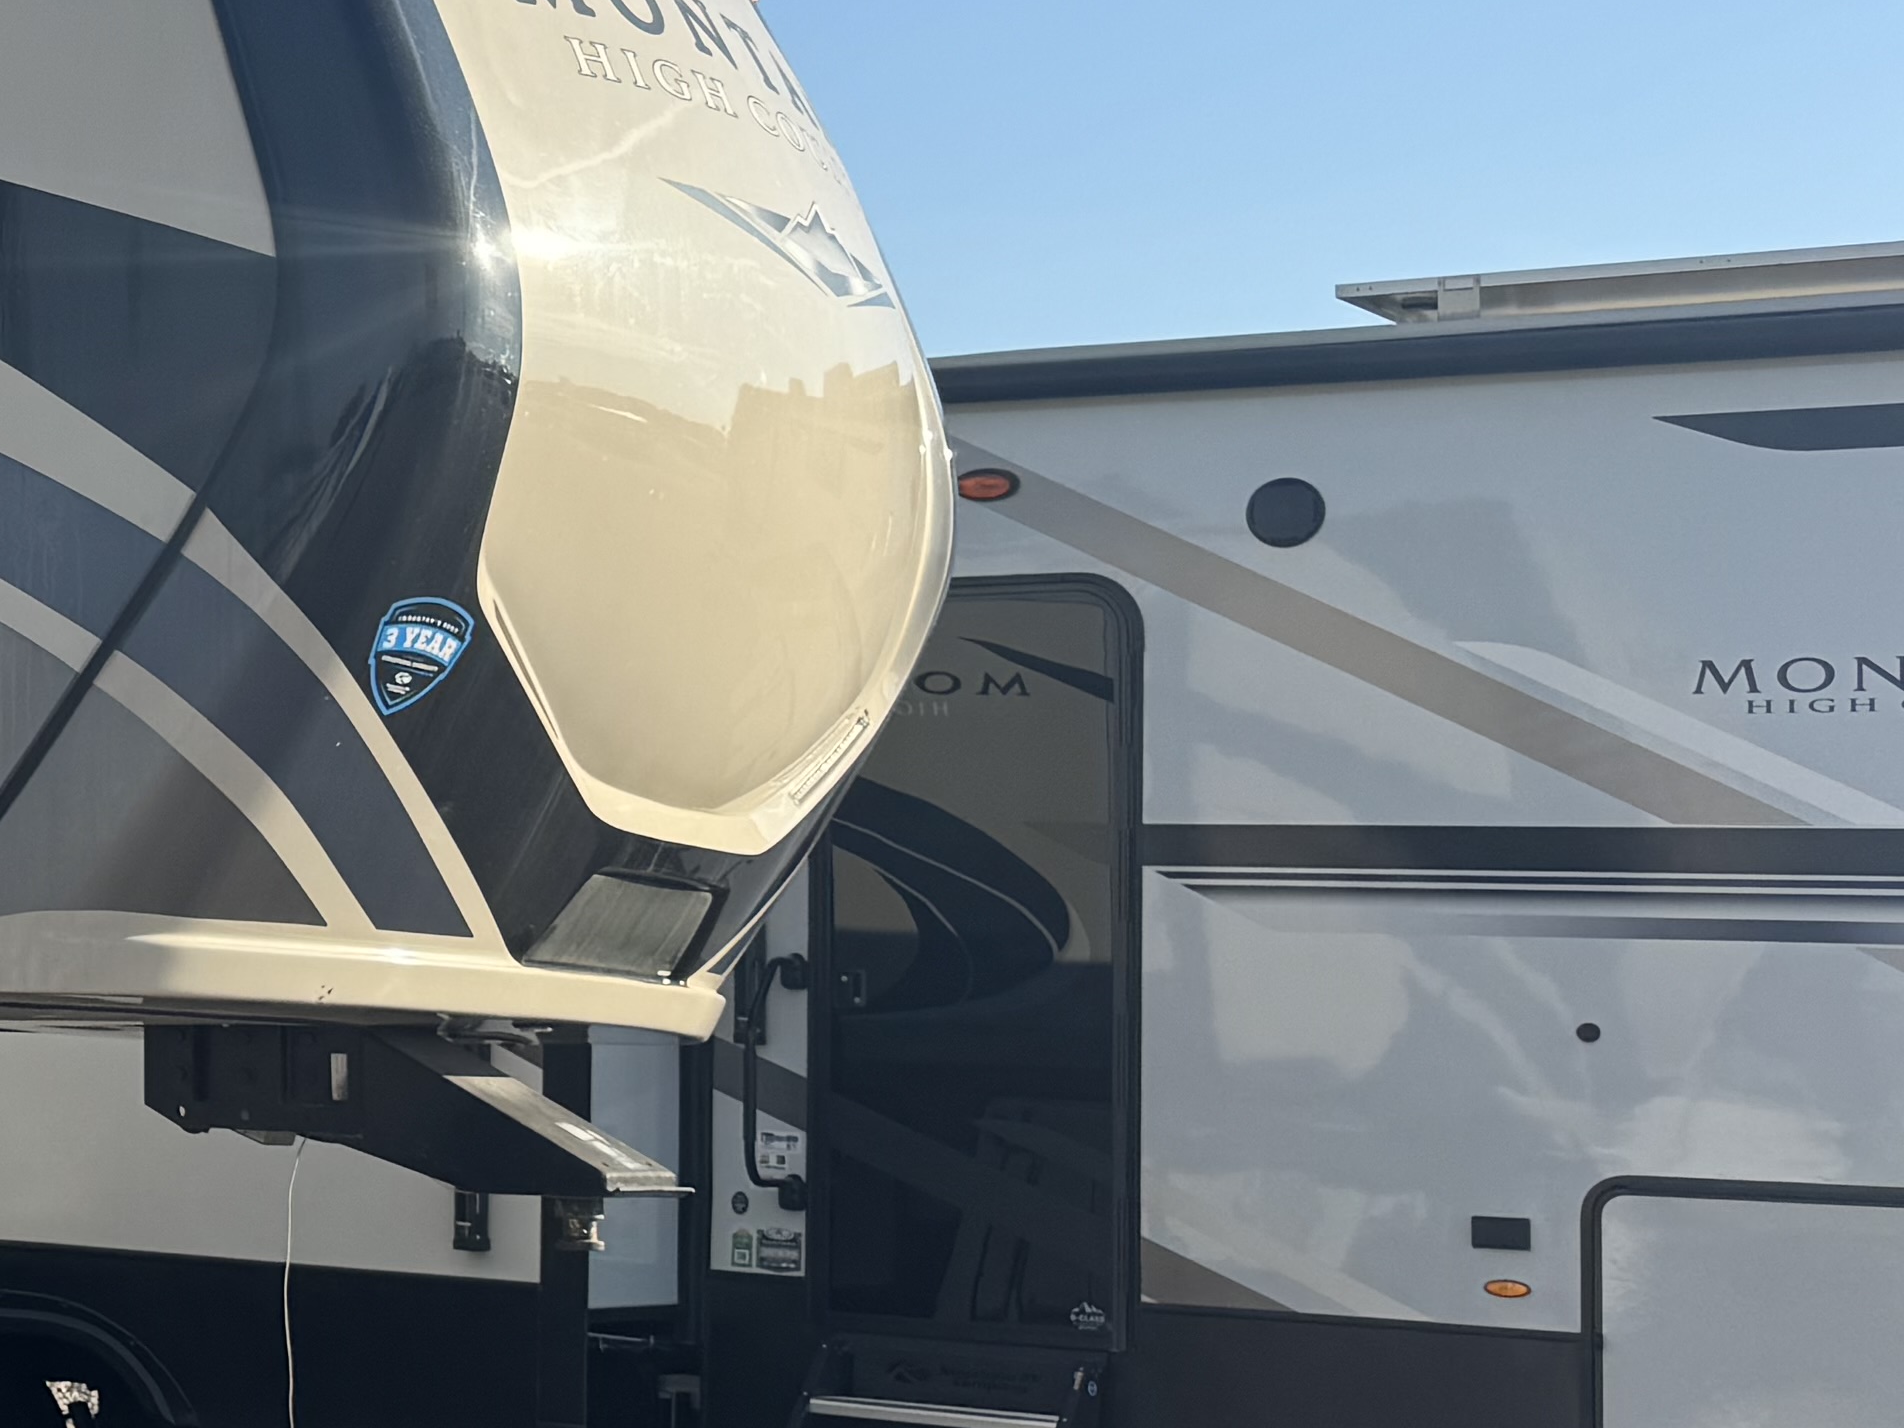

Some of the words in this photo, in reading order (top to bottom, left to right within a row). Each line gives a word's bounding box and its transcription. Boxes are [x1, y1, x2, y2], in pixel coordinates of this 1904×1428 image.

[563, 35, 739, 118] HIGH
[382, 627, 399, 649] 3
[403, 626, 457, 661] YEAR
[1746, 697, 1877, 715] HIGH
